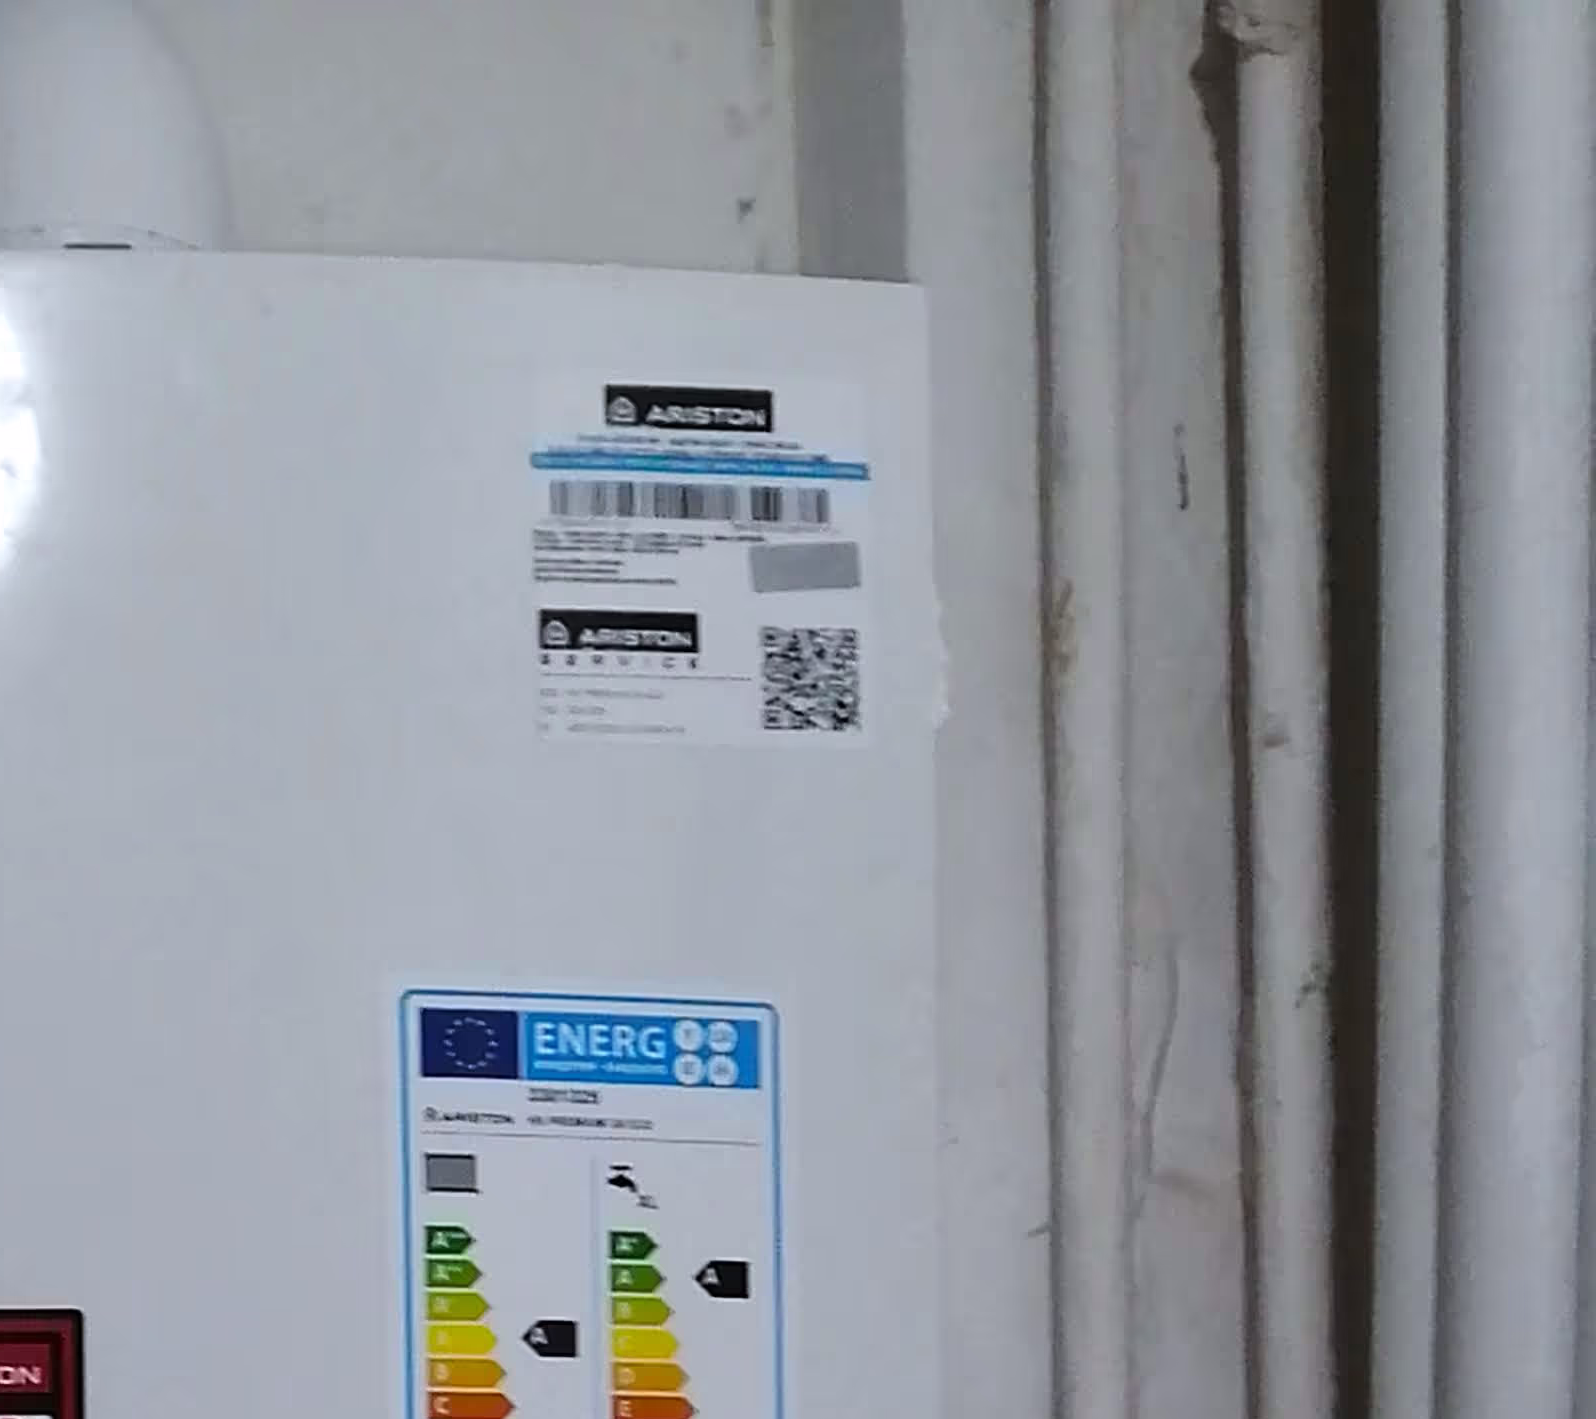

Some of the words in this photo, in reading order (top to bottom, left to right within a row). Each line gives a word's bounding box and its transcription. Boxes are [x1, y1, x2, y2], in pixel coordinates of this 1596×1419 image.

[645, 404, 767, 427] ARISTON
[578, 627, 693, 648] ARISTON
[533, 1021, 666, 1059] ENERG
[701, 1266, 720, 1285] A
[619, 1399, 633, 1418] E
